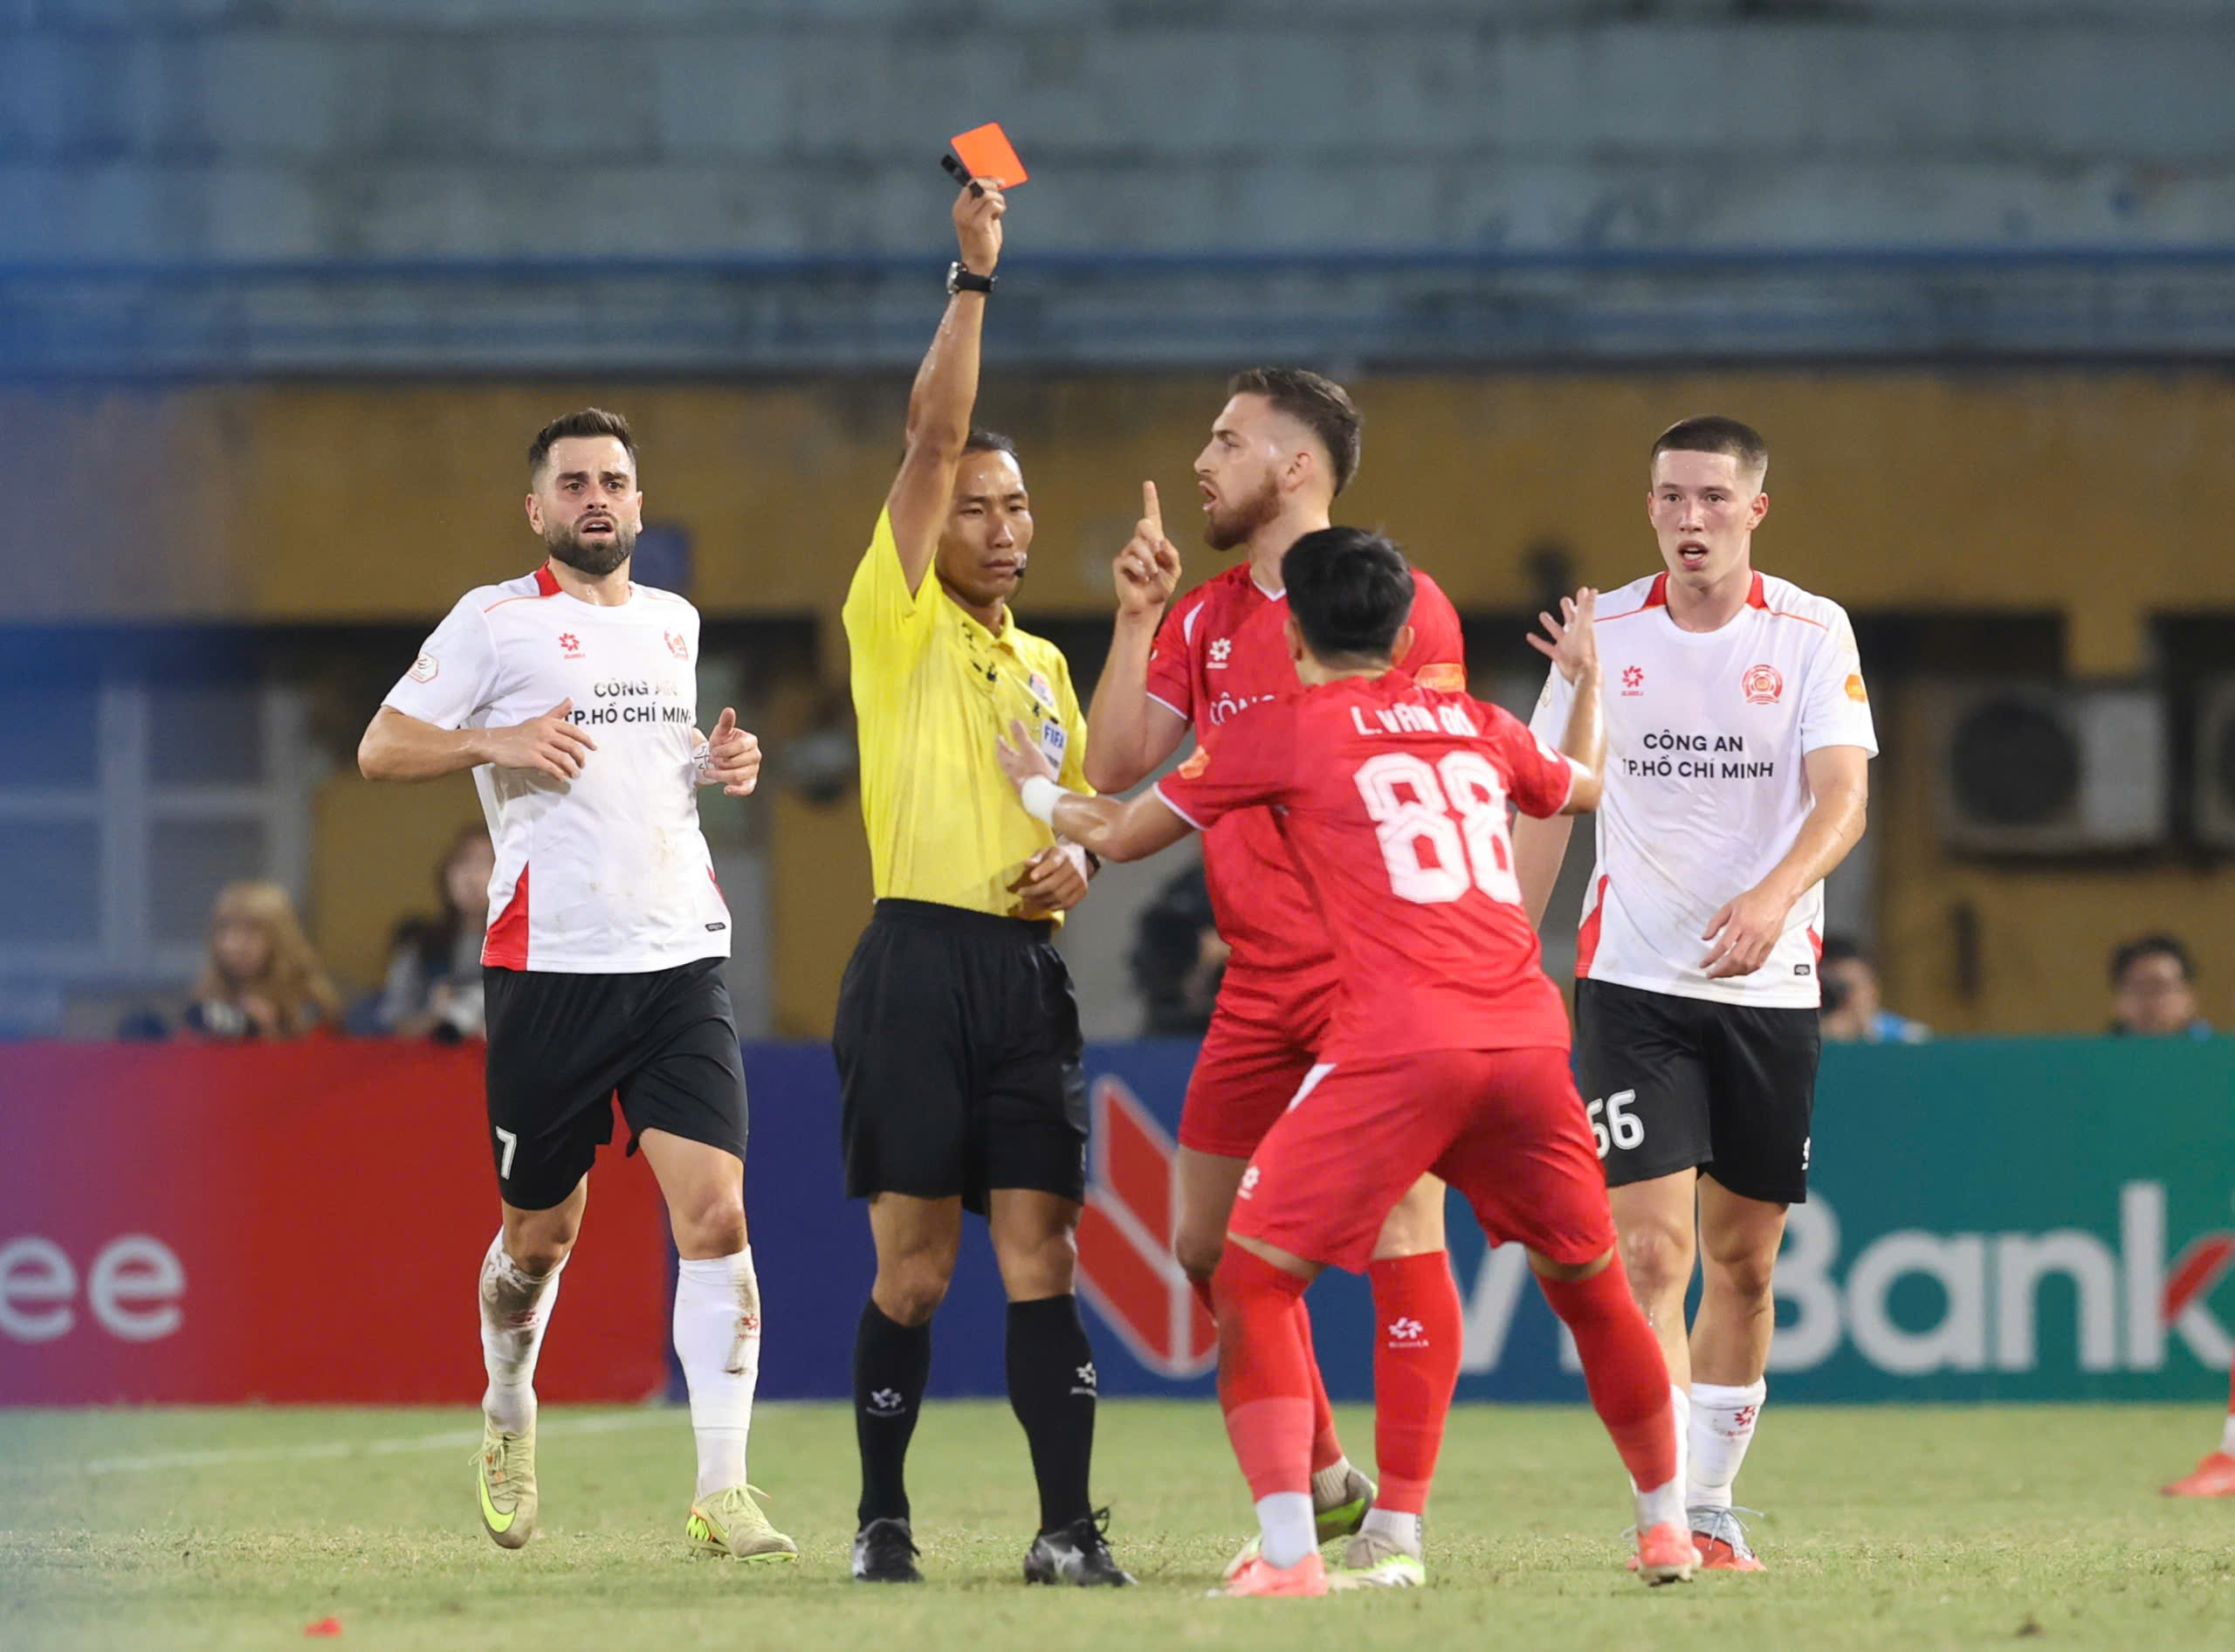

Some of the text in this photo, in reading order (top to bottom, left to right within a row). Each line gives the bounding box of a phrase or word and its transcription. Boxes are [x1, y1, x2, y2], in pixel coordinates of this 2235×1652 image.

[622, 701, 657, 723] CHÍ
[662, 706, 691, 725] MIN
[1044, 725, 1063, 748] FIFA
[1643, 729, 1743, 752] CÔNG AN
[1678, 758, 1715, 778] CHÍ
[1722, 761, 1774, 779] MINH
[1353, 750, 1523, 905] 88
[495, 1125, 517, 1180] 7
[0, 1234, 187, 1341] ee
